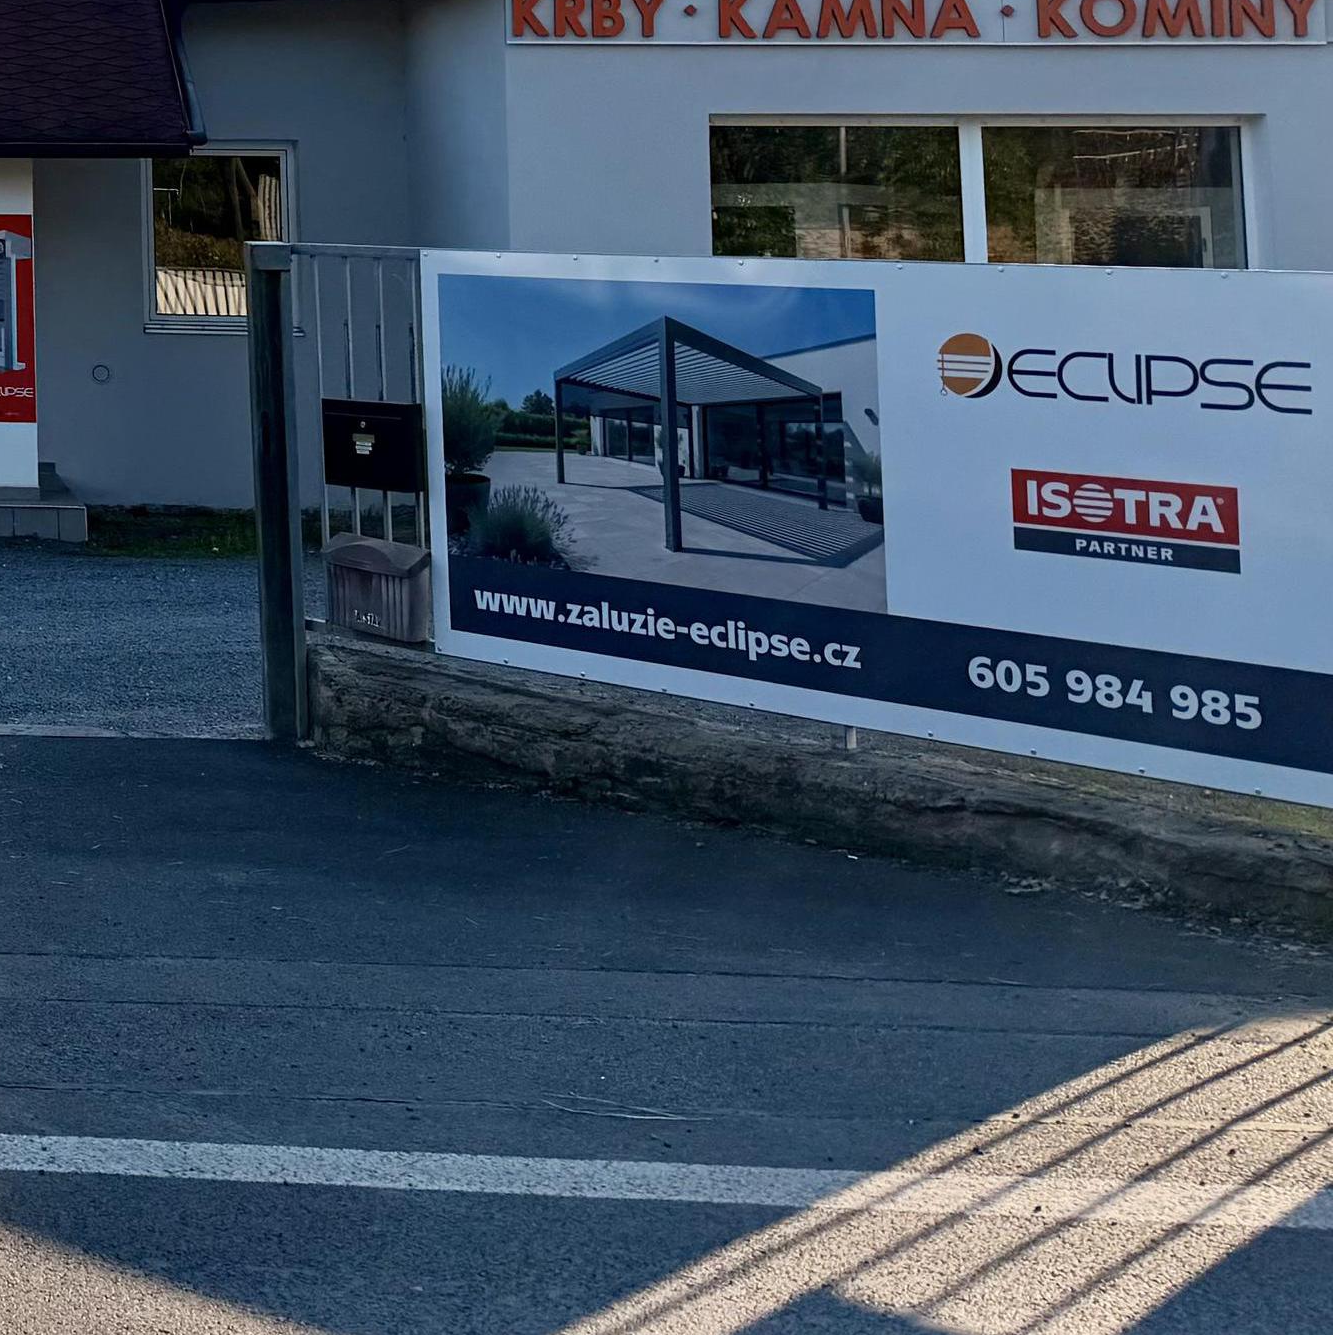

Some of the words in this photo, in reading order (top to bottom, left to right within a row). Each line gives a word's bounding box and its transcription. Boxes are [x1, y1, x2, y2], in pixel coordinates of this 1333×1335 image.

[1008, 347, 1313, 417] ECLIPSE
[1075, 537, 1174, 561] PARTNER
[473, 585, 862, 670] www.zaluzie-eclipse.cz
[967, 655, 1050, 699] 605
[1066, 668, 1153, 714] 984
[1169, 683, 1262, 731] 985
